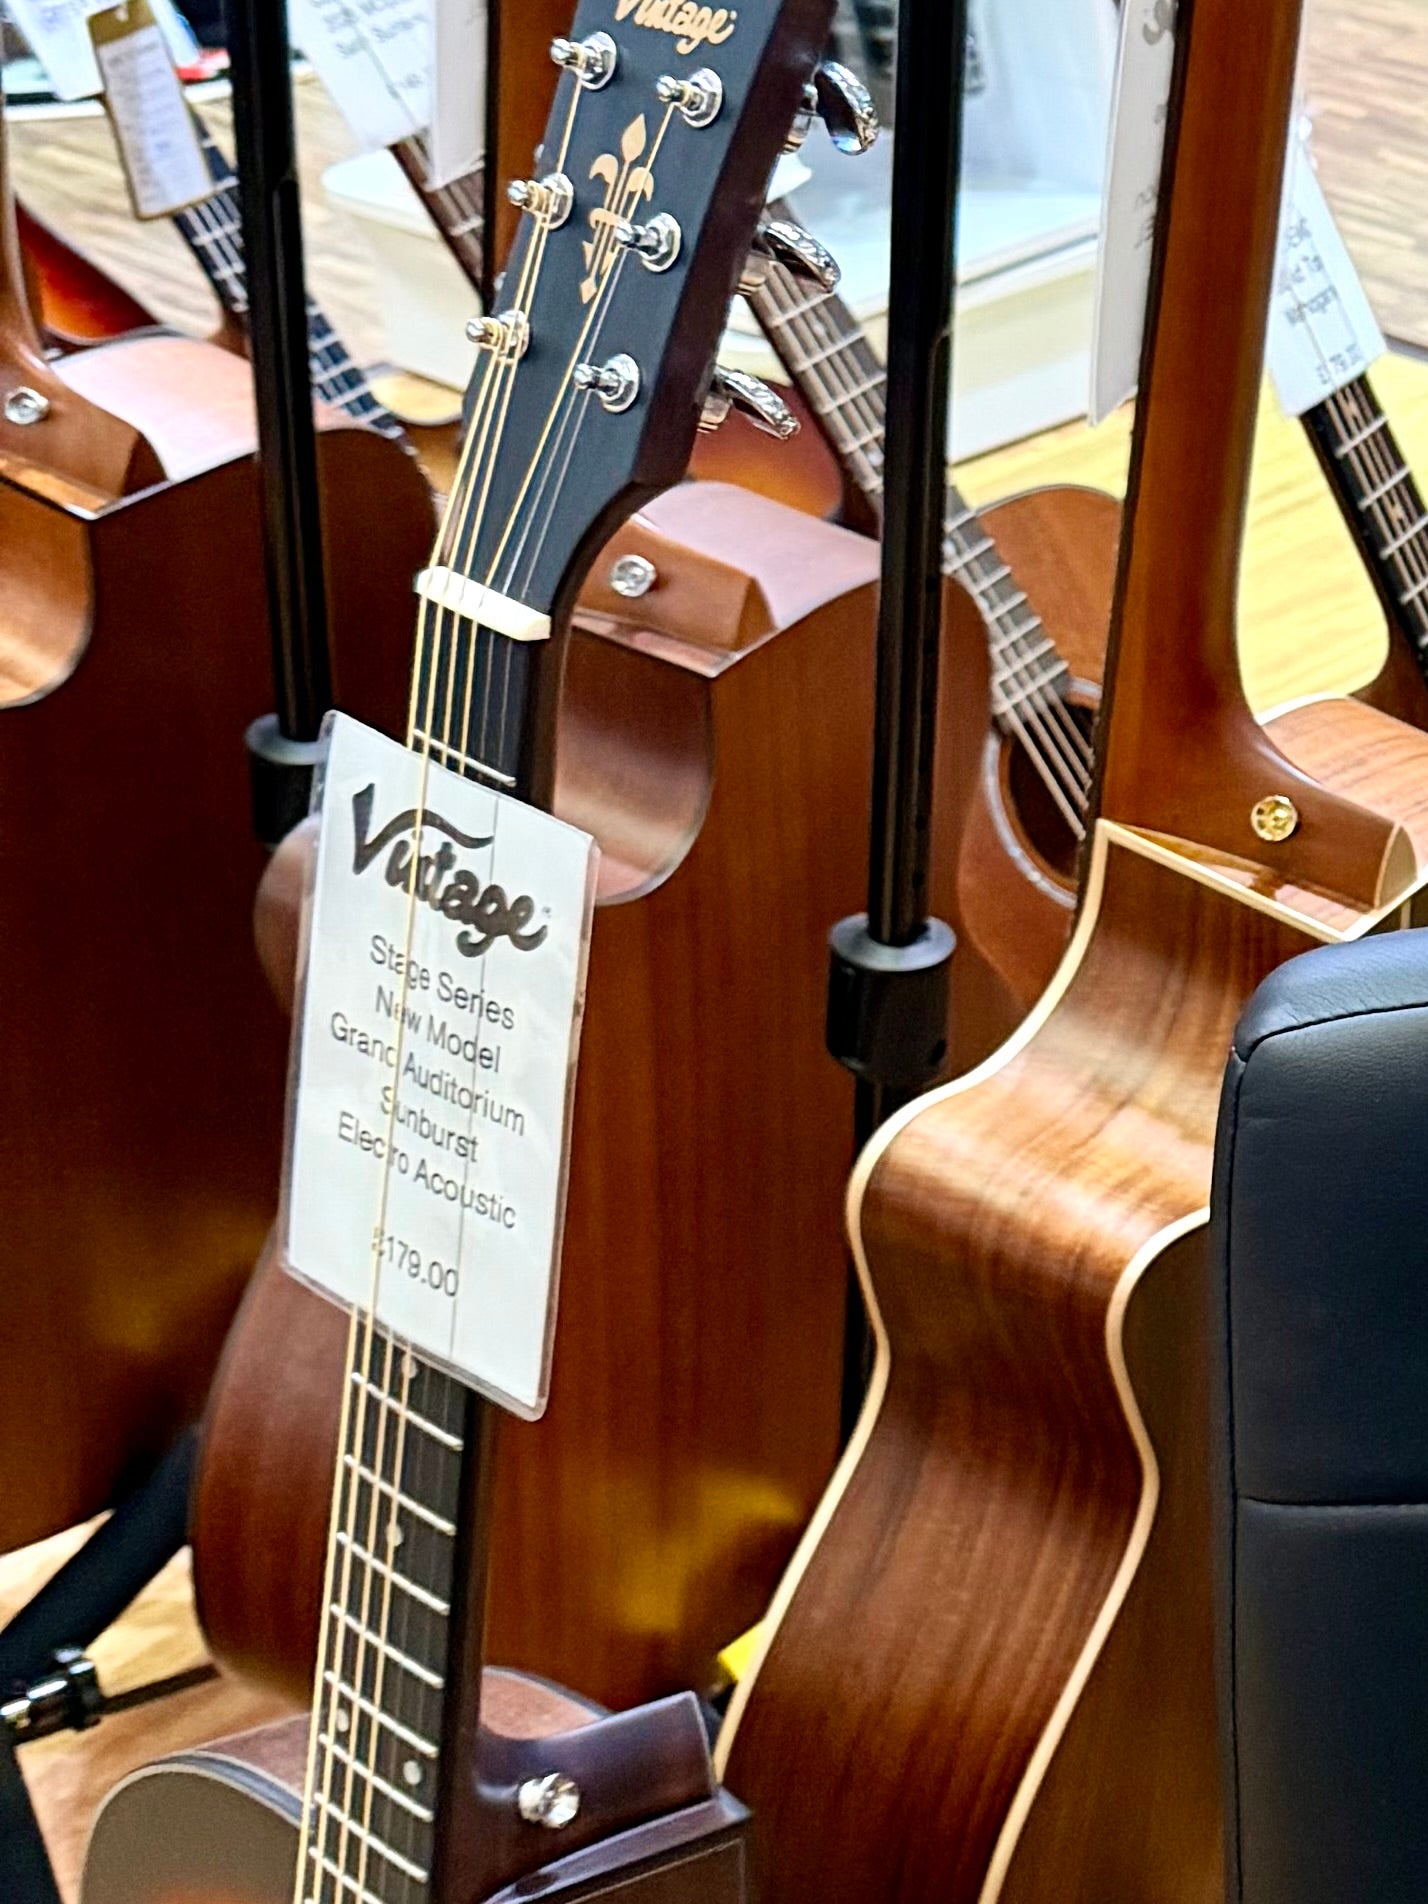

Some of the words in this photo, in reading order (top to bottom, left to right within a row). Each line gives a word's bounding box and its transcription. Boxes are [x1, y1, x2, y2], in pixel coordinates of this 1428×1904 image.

[351, 782, 550, 958] Vintage
[370, 934, 431, 990] Stage
[436, 971, 515, 1030] Series
[375, 985, 423, 1034] New
[426, 1015, 501, 1072] Model
[380, 1085, 479, 1163] Sunburst
[402, 1051, 526, 1136] Auditorium
[412, 1158, 517, 1230] Acoustic
